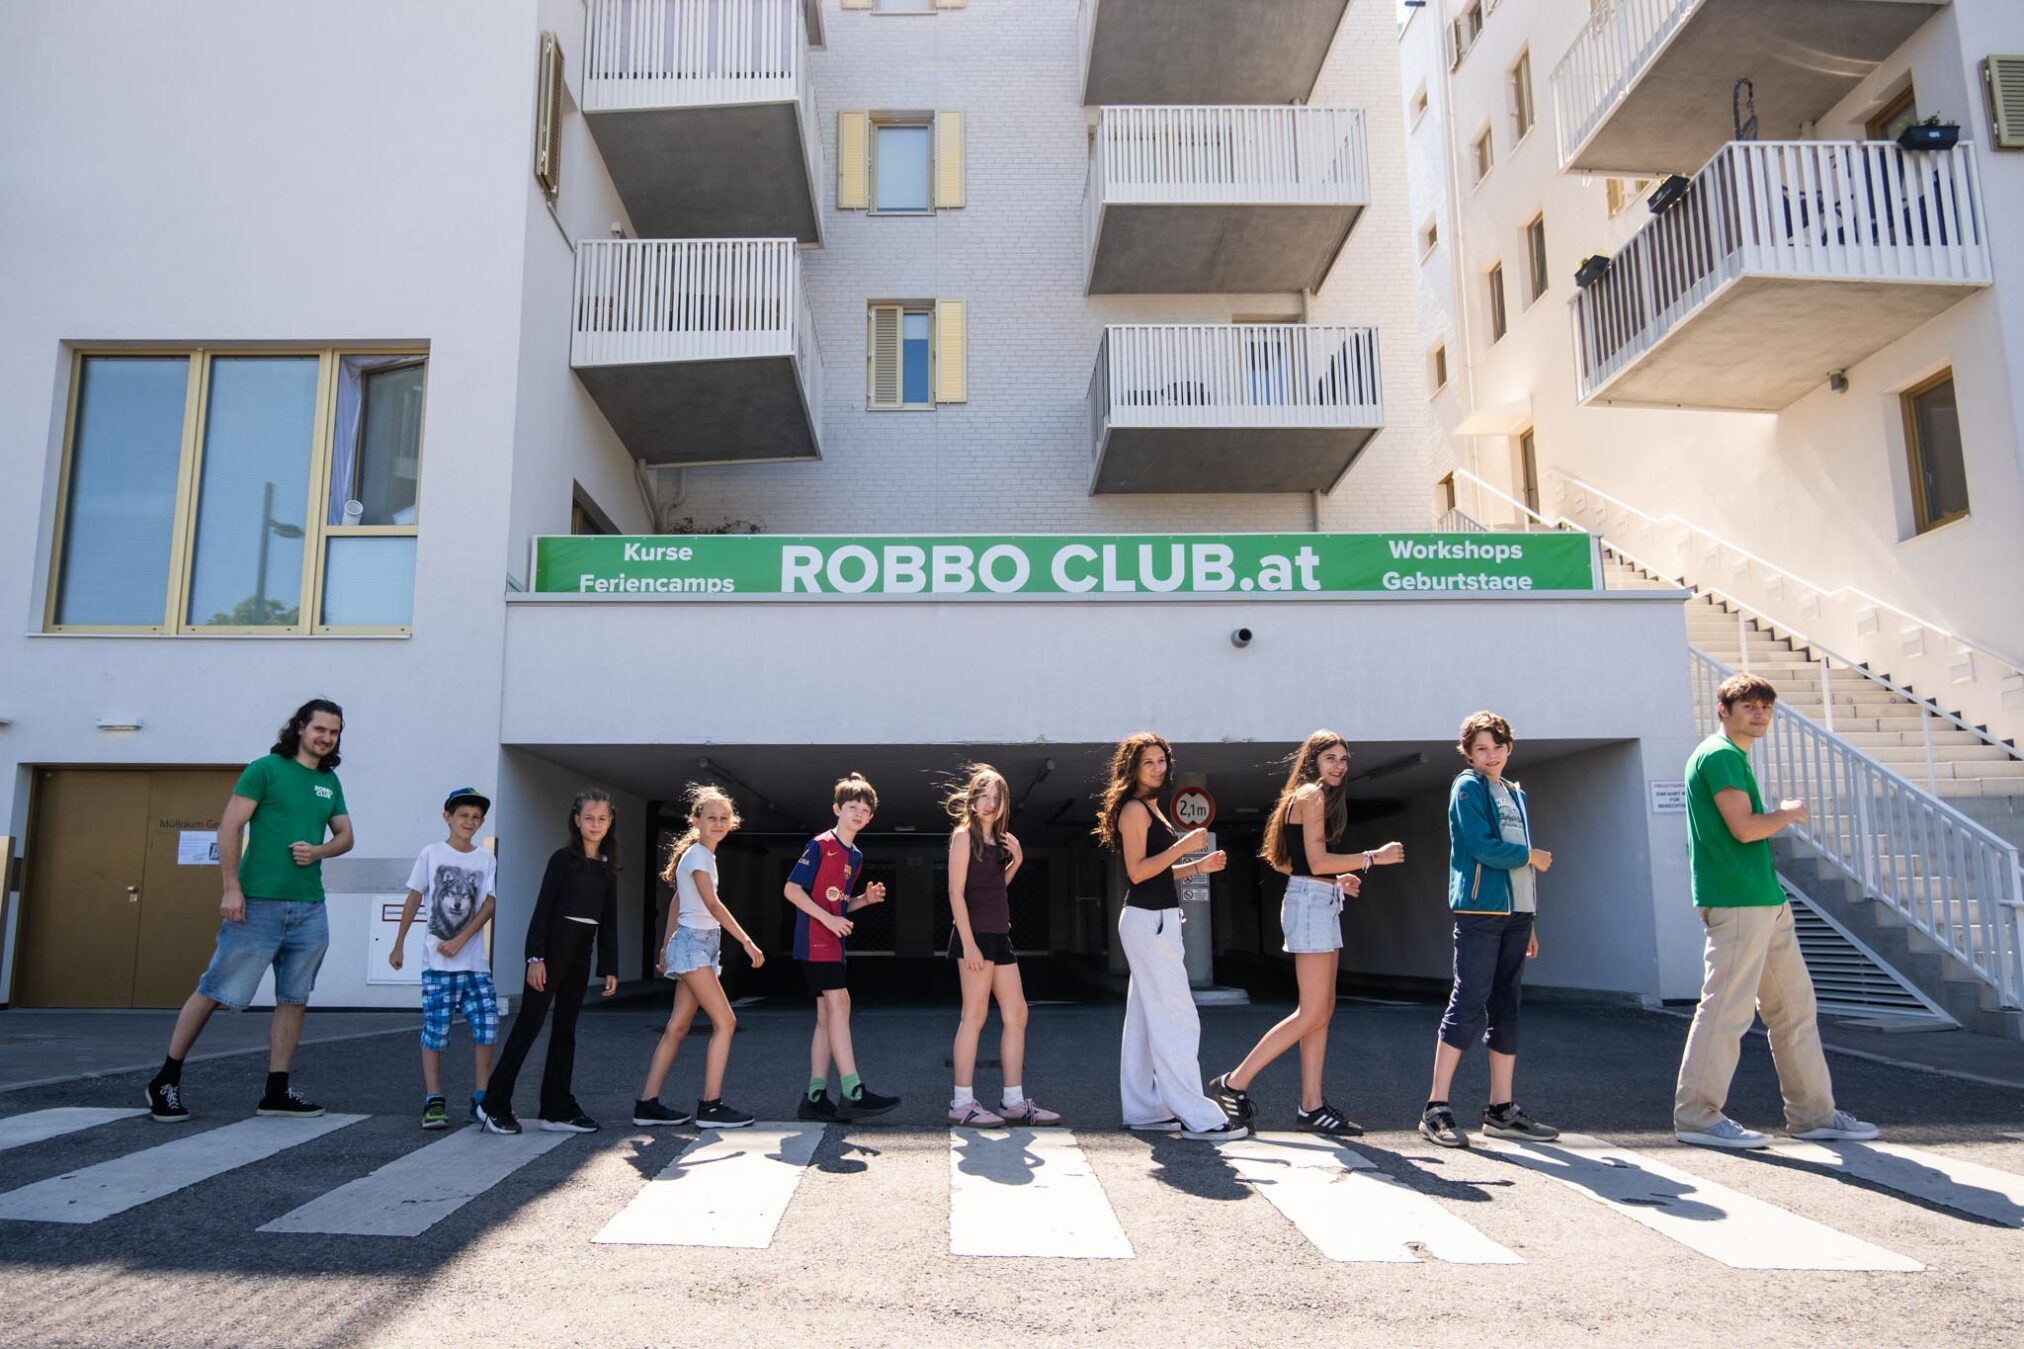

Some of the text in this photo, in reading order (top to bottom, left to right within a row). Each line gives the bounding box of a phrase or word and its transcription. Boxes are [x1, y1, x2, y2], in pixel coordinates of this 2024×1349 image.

[623, 542, 693, 561] Kurse
[1388, 540, 1523, 564] Workshops
[780, 543, 1322, 594] ROBBO CLUB.at
[579, 573, 735, 593] Feriencamps
[1382, 571, 1533, 591] Geburtstage
[159, 817, 204, 829] Müllraum
